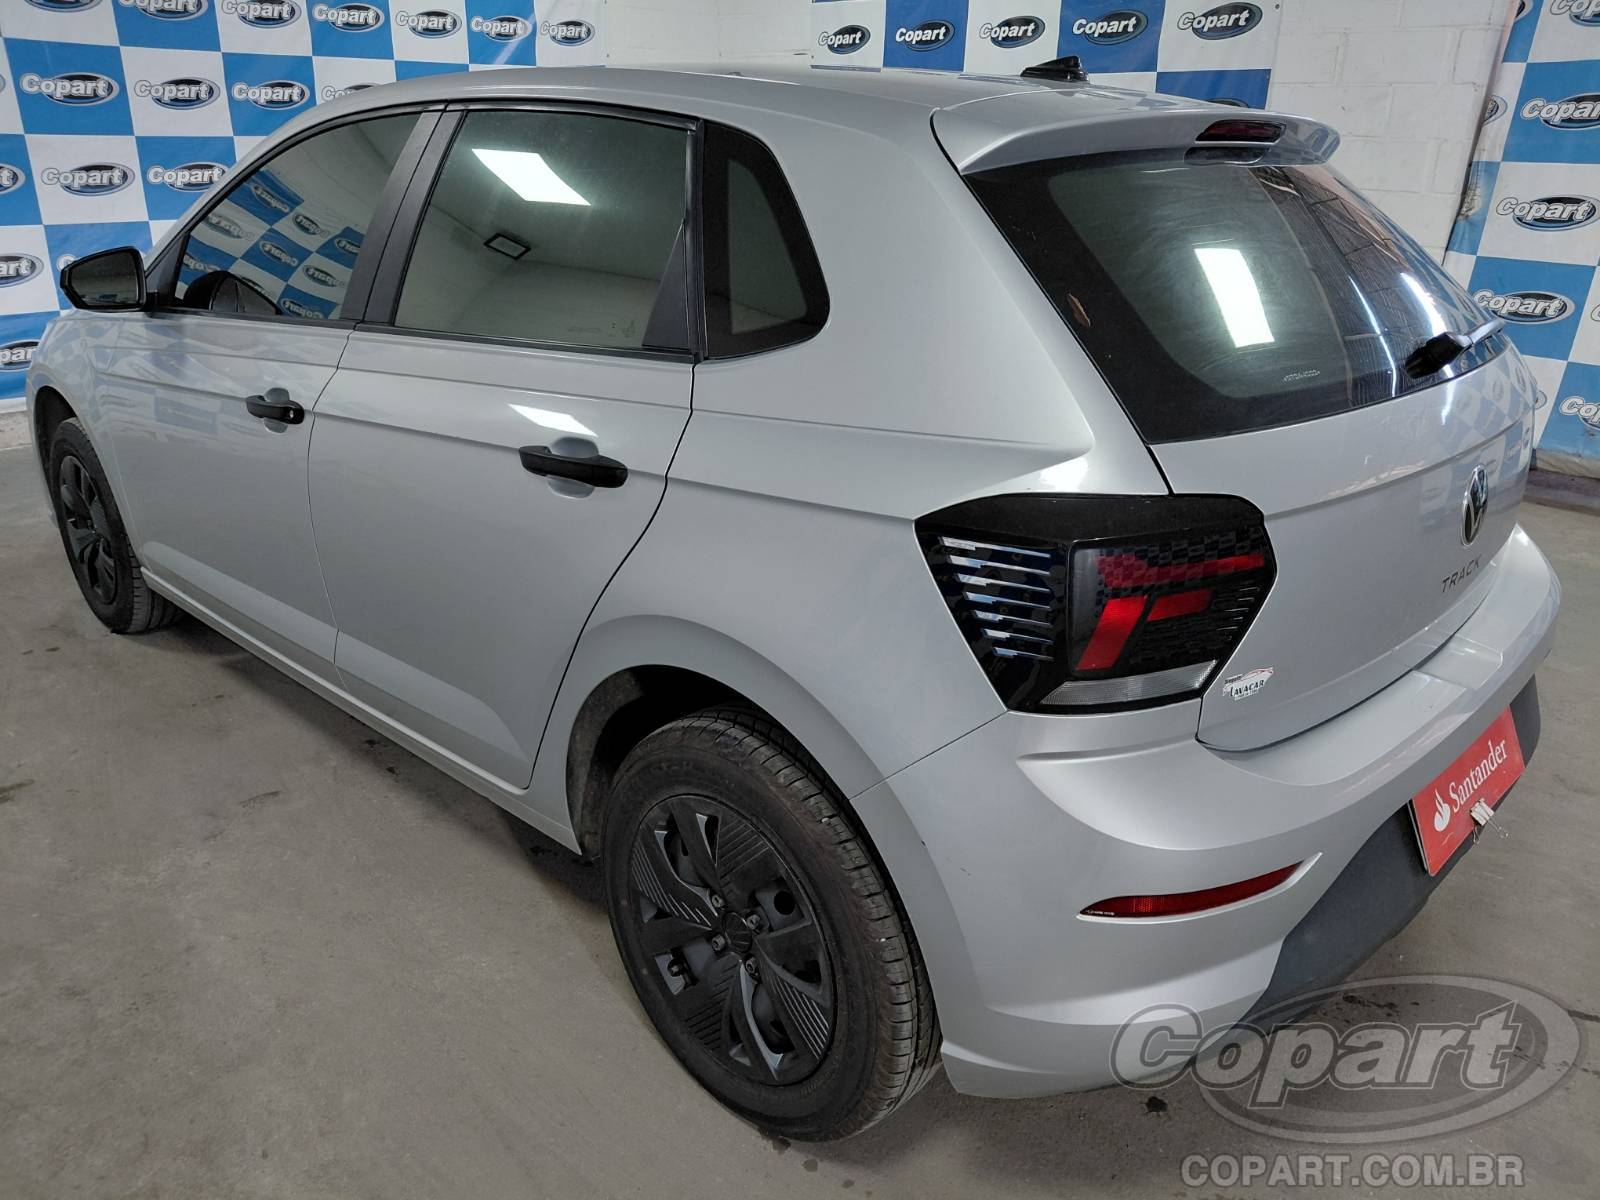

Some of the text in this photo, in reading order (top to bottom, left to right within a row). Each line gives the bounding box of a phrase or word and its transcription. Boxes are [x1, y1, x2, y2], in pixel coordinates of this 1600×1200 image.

[222, 0, 291, 19] Copart
[312, 4, 377, 26] Copart
[396, 10, 454, 32] Copart
[471, 16, 522, 37] Copart
[541, 20, 587, 39] Copart
[979, 22, 1036, 42] Copart
[1072, 16, 1137, 38] Copart
[1177, 9, 1250, 33] Copart
[818, 30, 862, 48] Copart
[895, 25, 946, 44] Copart
[20, 73, 109, 98] Copart
[134, 79, 208, 101] Copart
[232, 82, 302, 102] Copart
[41, 166, 124, 188] Copart
[147, 165, 221, 187] Copart
[1496, 196, 1594, 222] Copart
[1473, 289, 1562, 316] Copart
[1441, 554, 1482, 593] TRACK
[1448, 739, 1508, 813] Santander
